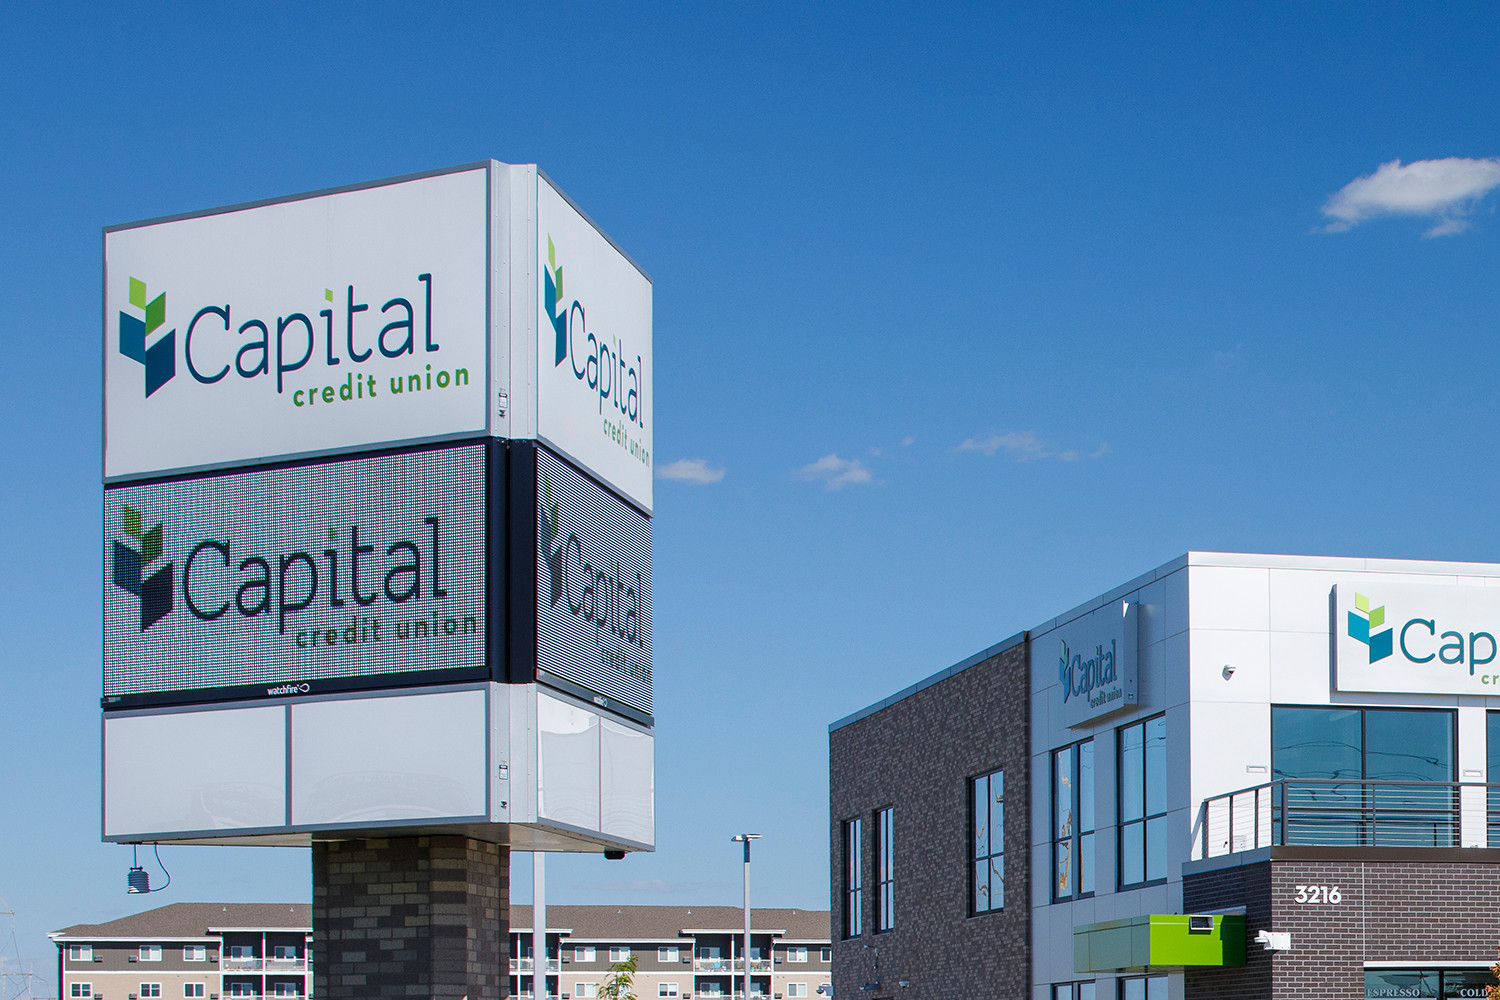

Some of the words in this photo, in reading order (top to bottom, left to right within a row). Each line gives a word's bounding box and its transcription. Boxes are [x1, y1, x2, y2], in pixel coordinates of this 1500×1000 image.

[185, 273, 440, 394] Capital
[293, 373, 378, 407] credit
[390, 364, 469, 394] union
[569, 300, 644, 429] Capital
[603, 418, 628, 450] credit
[630, 437, 650, 468] union
[183, 516, 448, 635] Capital
[565, 531, 644, 648] Capital
[296, 616, 382, 649] credit
[398, 612, 478, 639] union
[267, 684, 299, 695] watchfire
[1071, 638, 1118, 703] Capital
[1294, 885, 1342, 904] 3216
[1367, 988, 1421, 997] ESPRESSO
[1460, 988, 1488, 997] COLD
